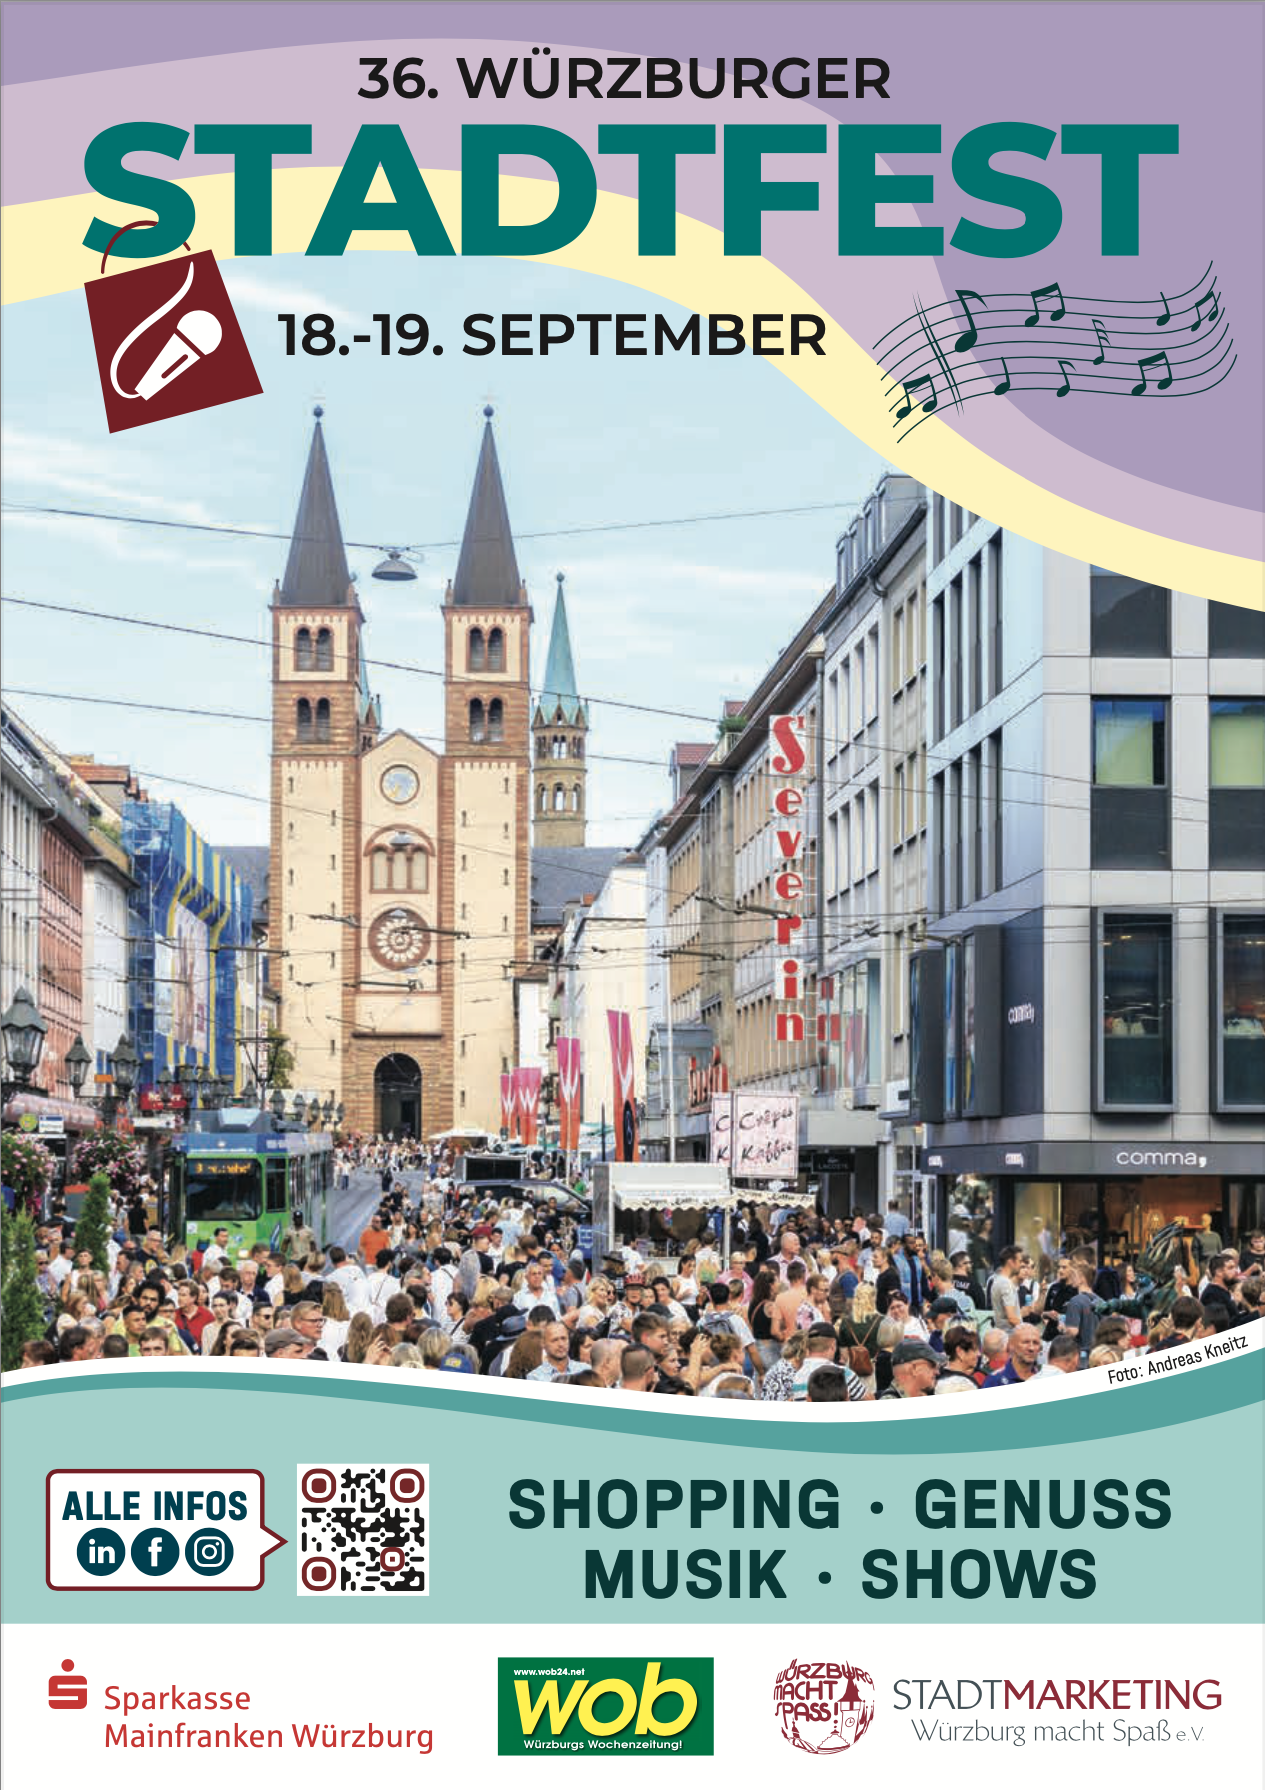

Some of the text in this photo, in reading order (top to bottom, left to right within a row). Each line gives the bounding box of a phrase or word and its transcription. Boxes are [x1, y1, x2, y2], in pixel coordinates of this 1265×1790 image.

[357, 47, 891, 100] 36. WÜRZBURGER
[82, 121, 1180, 260] STADTFEST
[277, 313, 826, 357] 18.-19. SEPTEMBER
[773, 715, 806, 1041] Severin
[61, 1490, 248, 1522] ALLE INFOS
[509, 1478, 1172, 1530] SHOPPING GENUSS
[585, 1548, 1097, 1600] MUSIK SHOWS
[513, 1667, 586, 1677] www.wob24.net
[775, 1657, 876, 1691] WÜRZBURG
[104, 1684, 251, 1717] Sparkasse
[513, 1661, 698, 1737] wob
[773, 1679, 839, 1702] MACHT
[893, 1678, 1222, 1711] STADTMARKETING
[105, 1721, 433, 1755] Mainfranken Würzburg
[523, 1739, 683, 1751] Würzburgs Wochenzeitung!
[910, 1718, 1205, 1747] Würzburg macht Spaß e.V.
